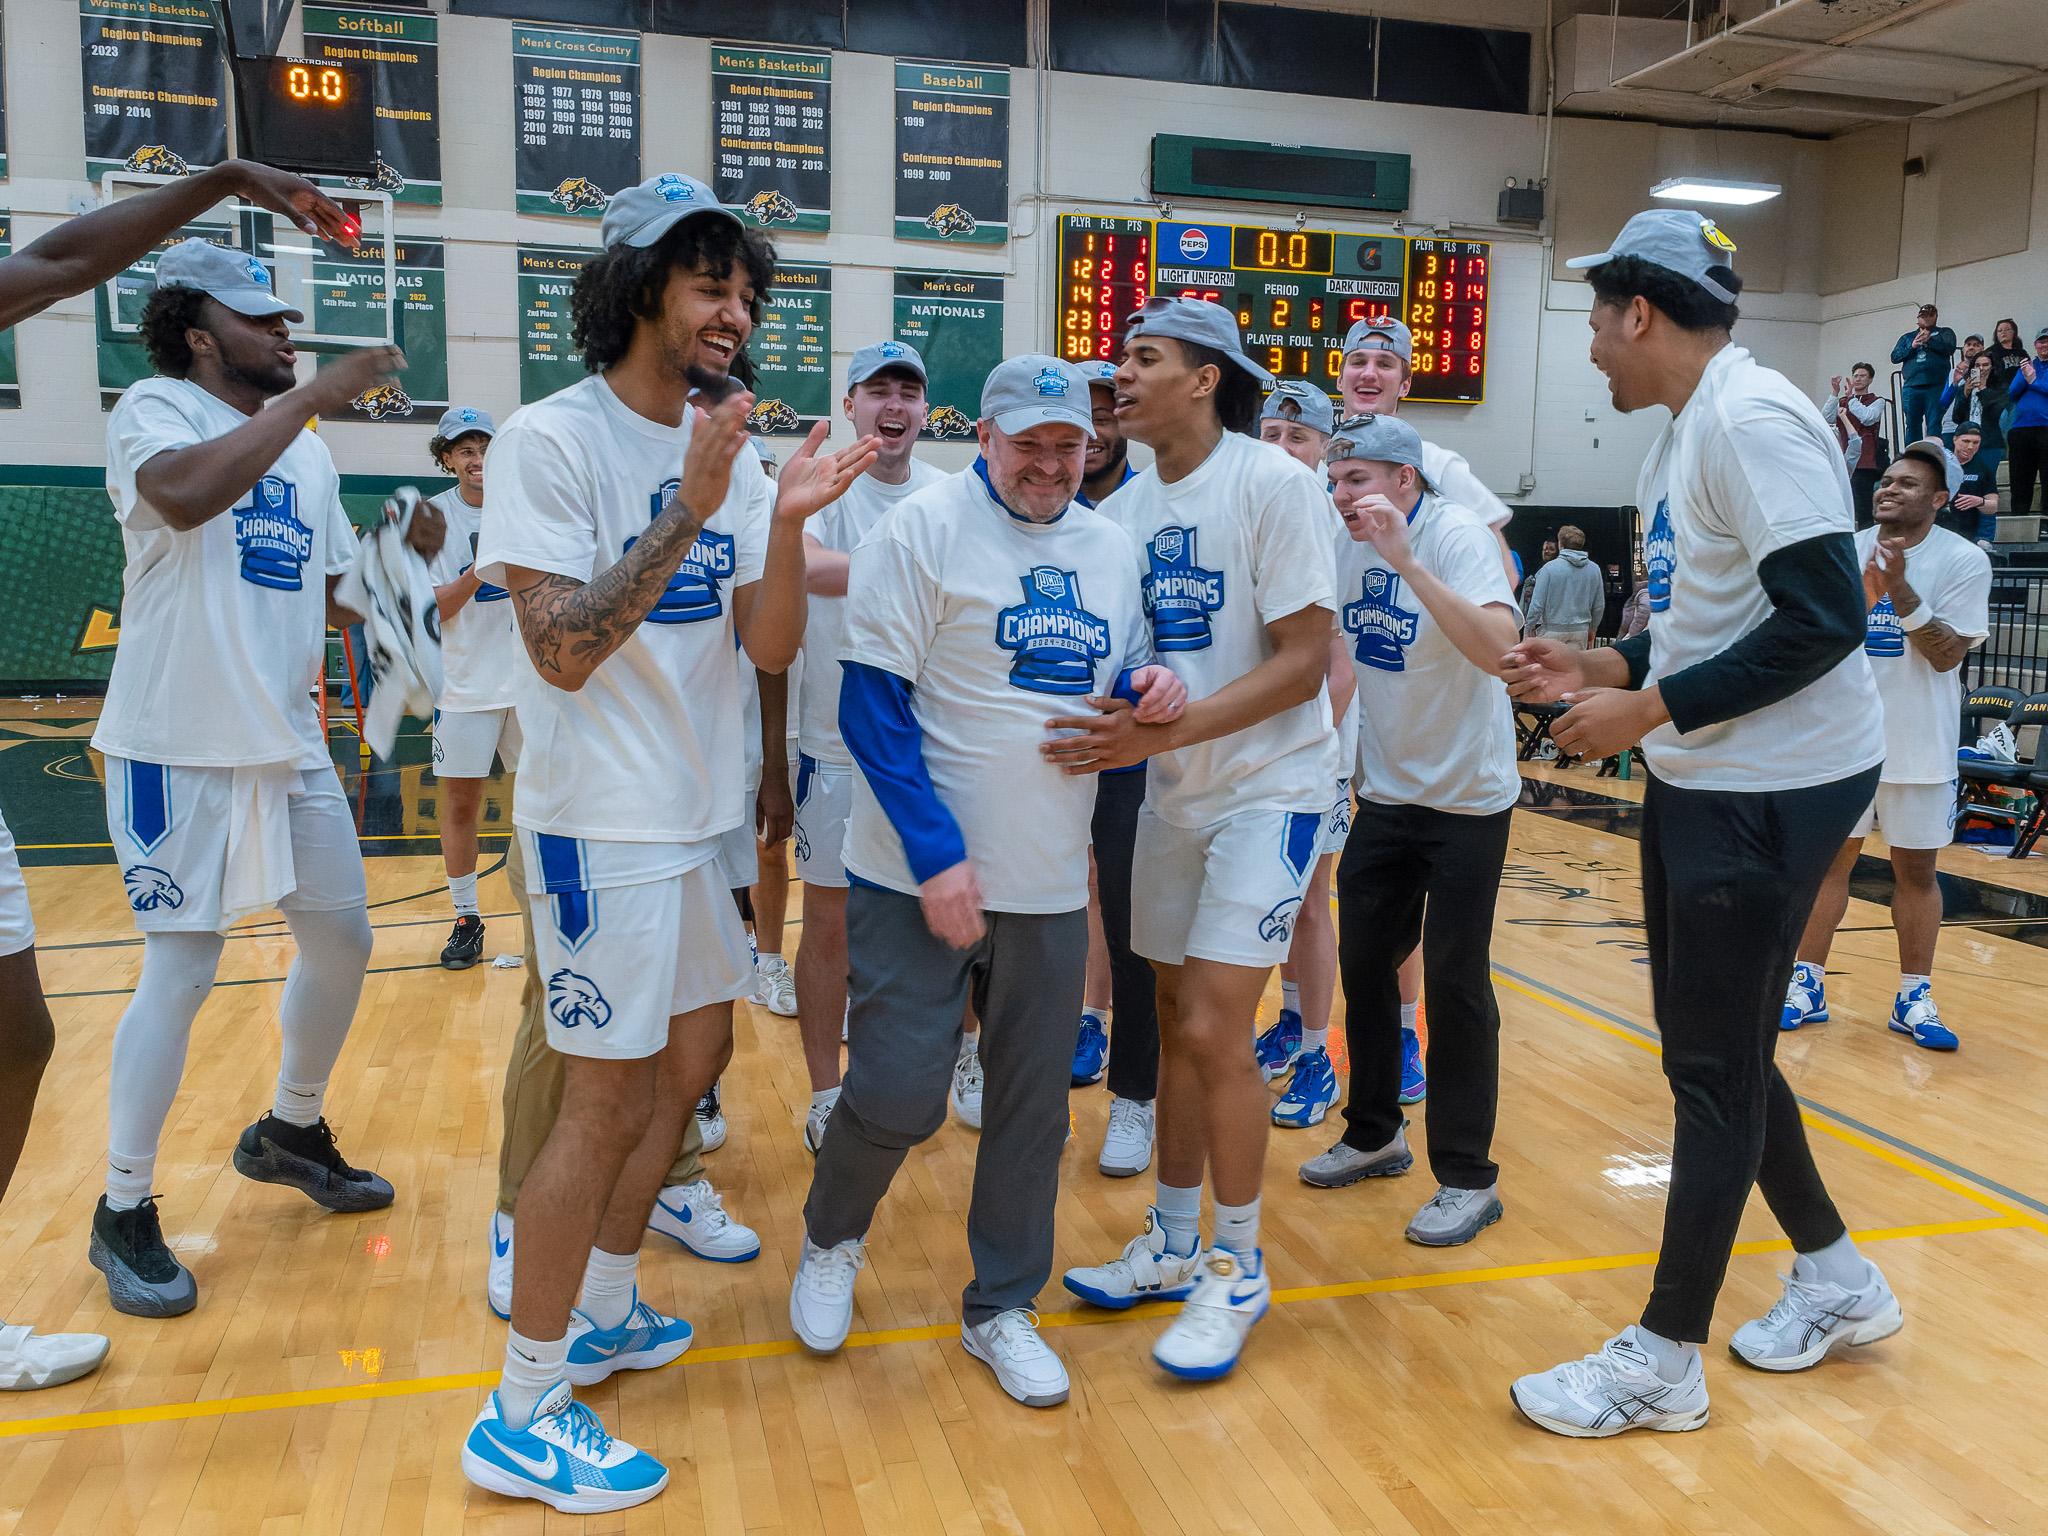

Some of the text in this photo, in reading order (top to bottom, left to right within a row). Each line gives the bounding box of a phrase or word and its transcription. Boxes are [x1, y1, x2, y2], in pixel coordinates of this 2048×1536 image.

[338, 16, 404, 34] Softball
[102, 27, 202, 46] Region Champions
[92, 45, 118, 56] 2023
[324, 46, 418, 64] Region Champions
[522, 37, 632, 57] Men's Cross Country
[287, 57, 342, 67] DAKTRONICS
[720, 56, 824, 74] Men's Basketball
[533, 66, 622, 84] Region Champions
[924, 73, 982, 89] Baseball
[290, 68, 340, 100] 0.0
[730, 84, 814, 100] Region Champions
[92, 86, 218, 106] Conference Champions
[523, 84, 632, 102] 1976 1977 1979 1989
[94, 104, 152, 118] 1998 2014
[523, 96, 632, 114] 1992 1993 1994 1996
[721, 101, 823, 118] 1991 1992 1998 1999
[912, 100, 992, 116] Region Champions
[376, 106, 432, 121] Champions
[524, 109, 632, 126] 1997 1998 1999 2000
[721, 113, 822, 130] 2000 2001 2008 2012
[903, 116, 924, 127] 1999
[524, 122, 631, 139] 2010 2011 2014 2015
[721, 124, 770, 137] 2018 2023
[524, 134, 546, 145] 2016
[721, 138, 824, 154] Conference Champions
[722, 154, 823, 170] 1998 2000 2012 2013
[903, 152, 1002, 168] Conference Champions
[722, 168, 743, 179] 2023
[903, 169, 950, 180] 1999 2000
[1070, 216, 1142, 232] PLYR FLS PTS
[1088, 234, 1146, 254] 1 1 1
[1181, 240, 1207, 249] PEPSI
[1259, 232, 1306, 268] 0.0
[1416, 240, 1480, 254] PLYR FLS PTS
[524, 258, 554, 268] Men's
[1074, 258, 1145, 281] 12 2 6
[1427, 256, 1484, 276] 3 1 17
[1162, 270, 1234, 286] LIGHT UNIFORM
[924, 282, 975, 292] Men's Golf
[1264, 284, 1299, 296] PERIOD
[1330, 281, 1398, 296] DARK UNIFORM
[1418, 280, 1483, 300] 10 3 14
[1074, 286, 1144, 306] 14 2 3
[540, 310, 557, 318] Place
[912, 305, 985, 318] NATIONALS
[1240, 312, 1249, 324] B
[1274, 300, 1288, 326] 2
[1412, 304, 1482, 326] 22 1 3
[1066, 310, 1110, 330] 23 0
[1312, 316, 1320, 328] B
[1068, 336, 1110, 356] 30 2
[1246, 334, 1314, 347] PLAYER FOUL
[1411, 329, 1480, 350] 24 3 8
[1270, 348, 1282, 374] 3
[1302, 351, 1307, 373] 1
[1412, 353, 1480, 374] 30 3 6
[1028, 608, 1084, 621] NATIONAL
[1348, 608, 1414, 640] CHAMPIONS
[1004, 614, 1106, 652] CHAMPIONS
[1032, 638, 1082, 651] 2024-2025
[1970, 697, 2014, 708] DANVILLE
